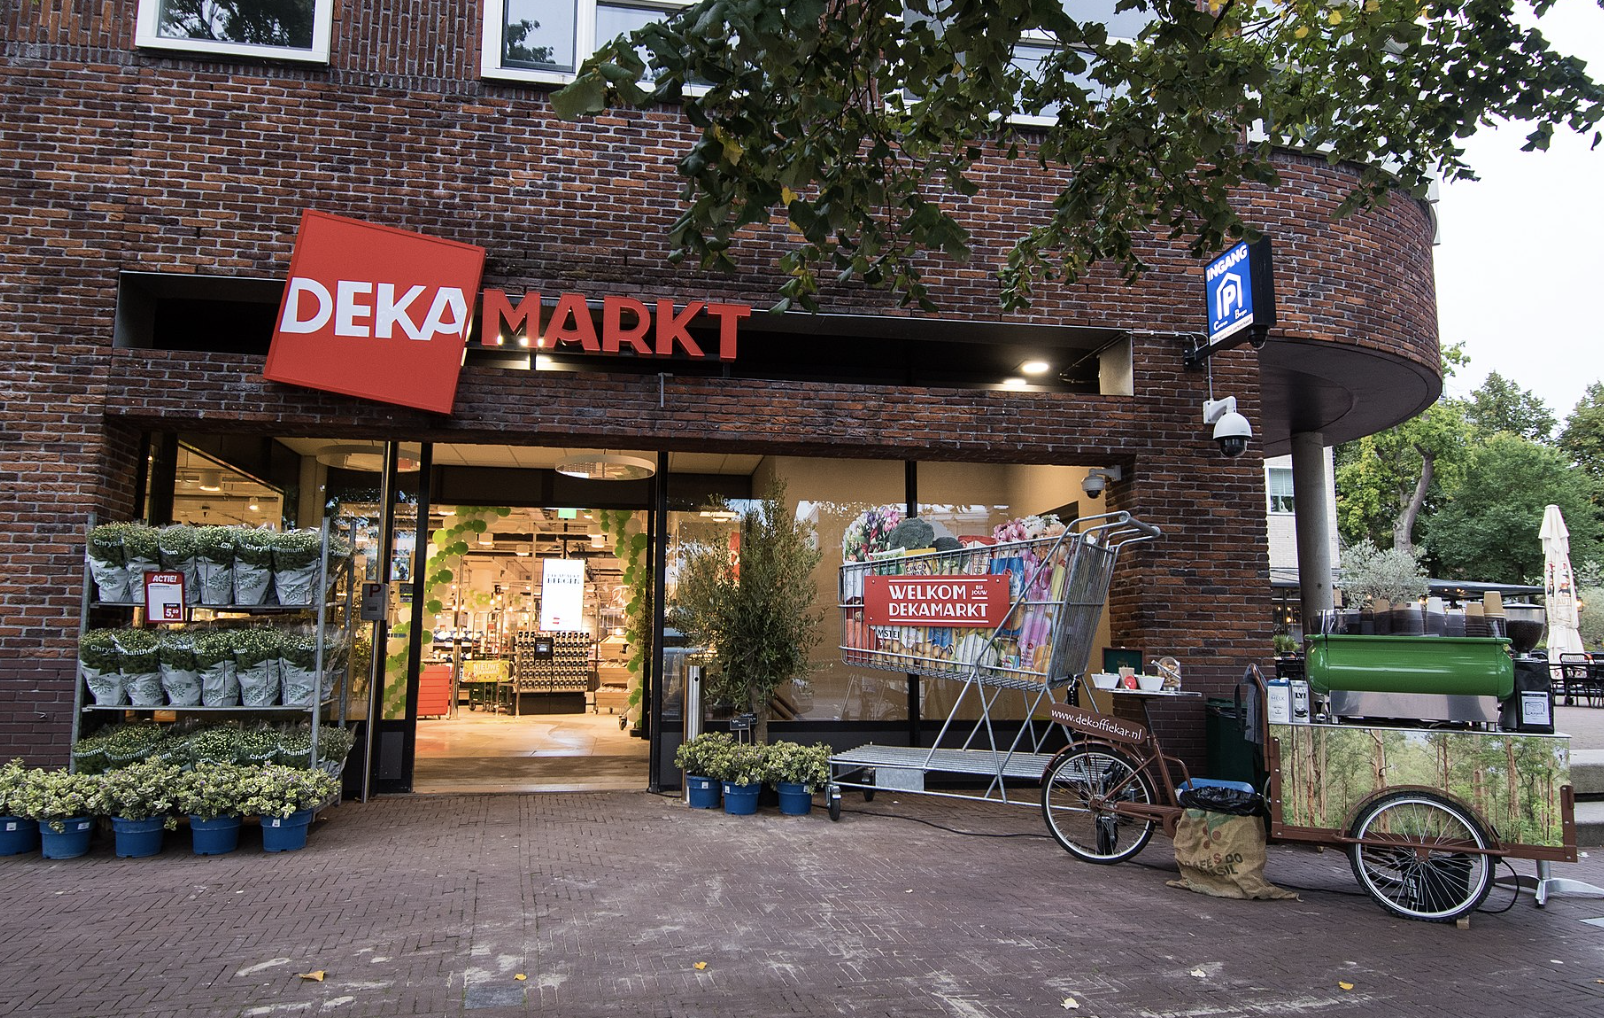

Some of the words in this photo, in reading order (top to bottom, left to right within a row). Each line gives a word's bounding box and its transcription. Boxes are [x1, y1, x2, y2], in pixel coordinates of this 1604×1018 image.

[1207, 244, 1248, 282] INGANG
[1222, 284, 1236, 317] P
[153, 575, 177, 583] ACTIE!
[369, 583, 381, 598] P
[889, 585, 967, 600] WELKOM
[888, 602, 989, 617] DEKAMARKT
[1051, 709, 1142, 740] www.dekoffiekar.nl
[1225, 853, 1243, 864] DO
